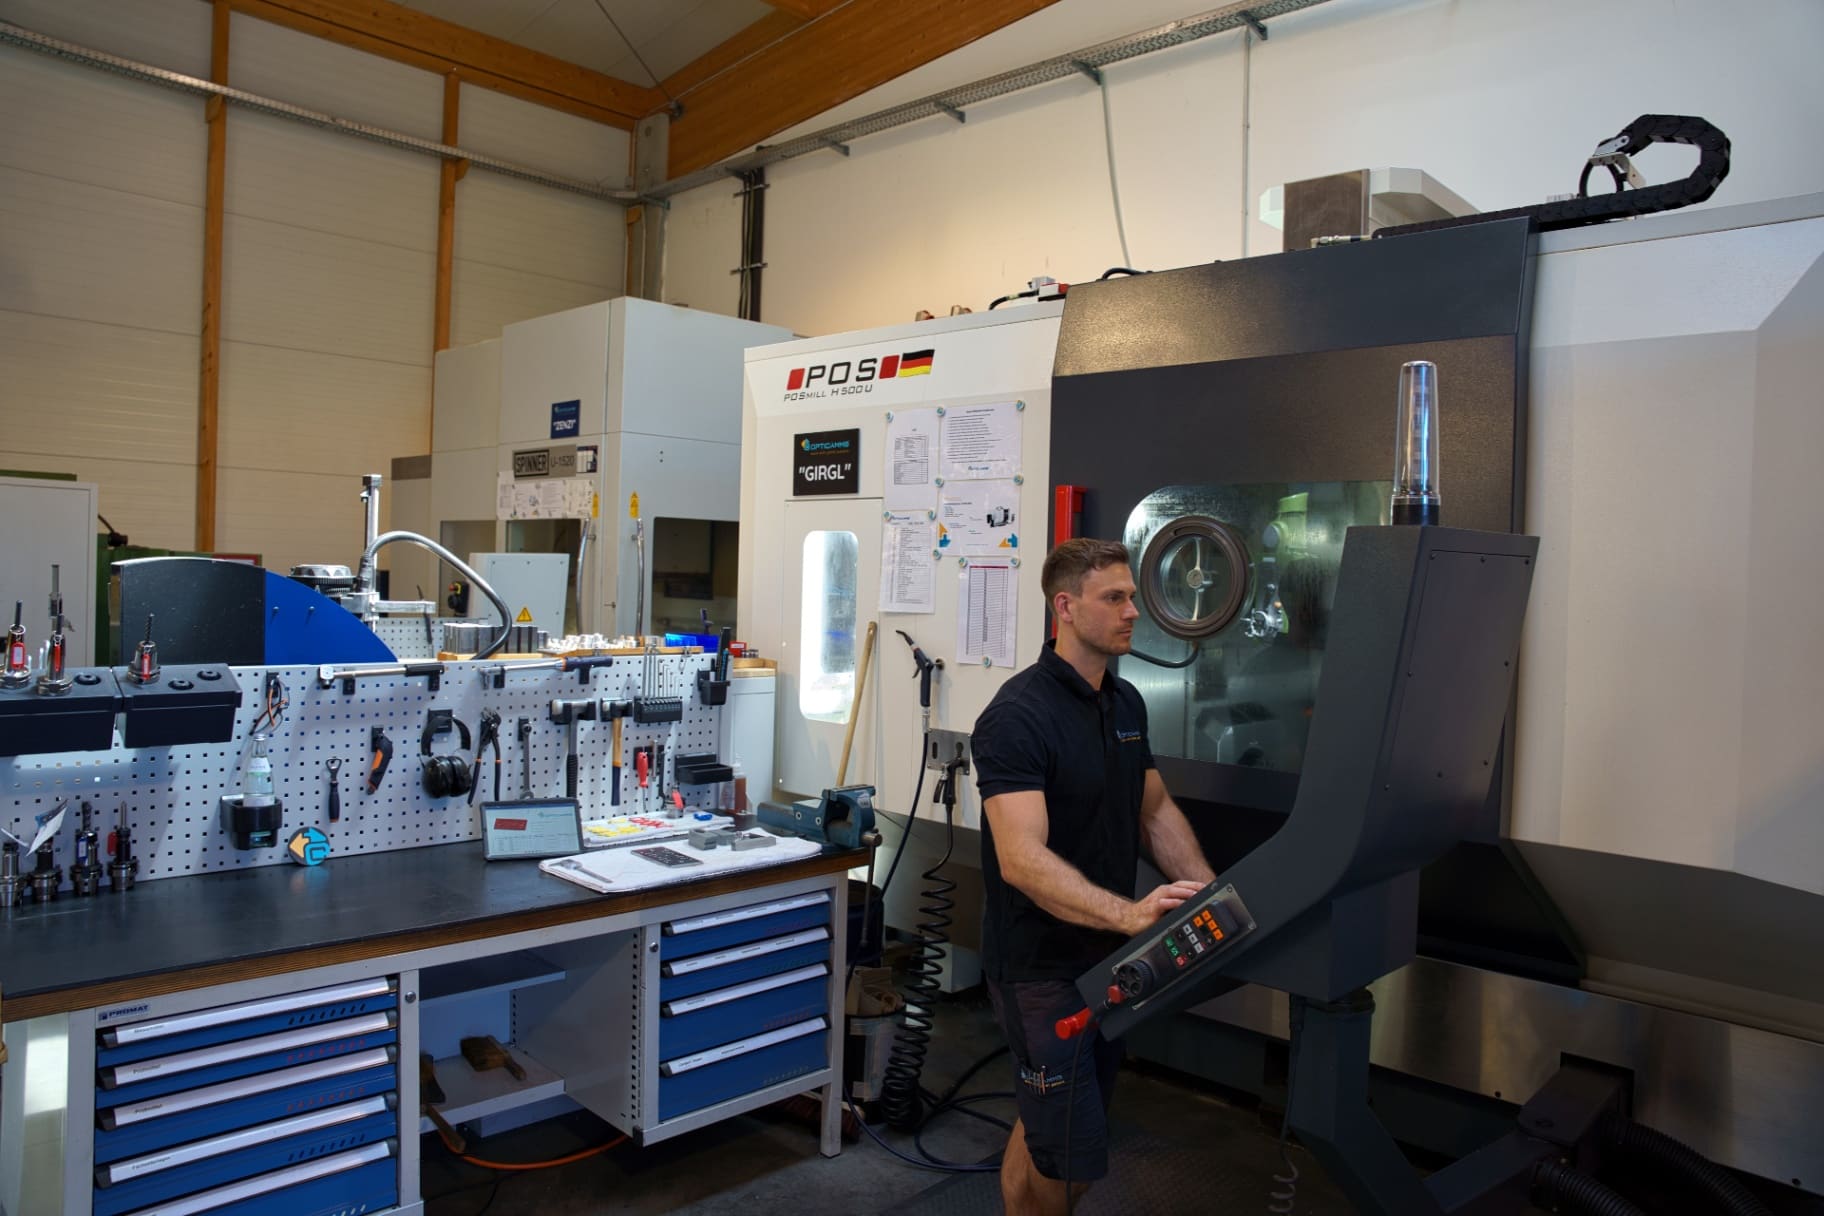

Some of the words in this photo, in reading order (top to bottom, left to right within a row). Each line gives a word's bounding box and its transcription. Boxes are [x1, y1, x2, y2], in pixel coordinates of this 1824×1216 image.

[805, 357, 878, 388] POS
[516, 454, 547, 473] SPINNER
[798, 463, 852, 482] "GIRGL"
[109, 1005, 149, 1017] PROMAT
